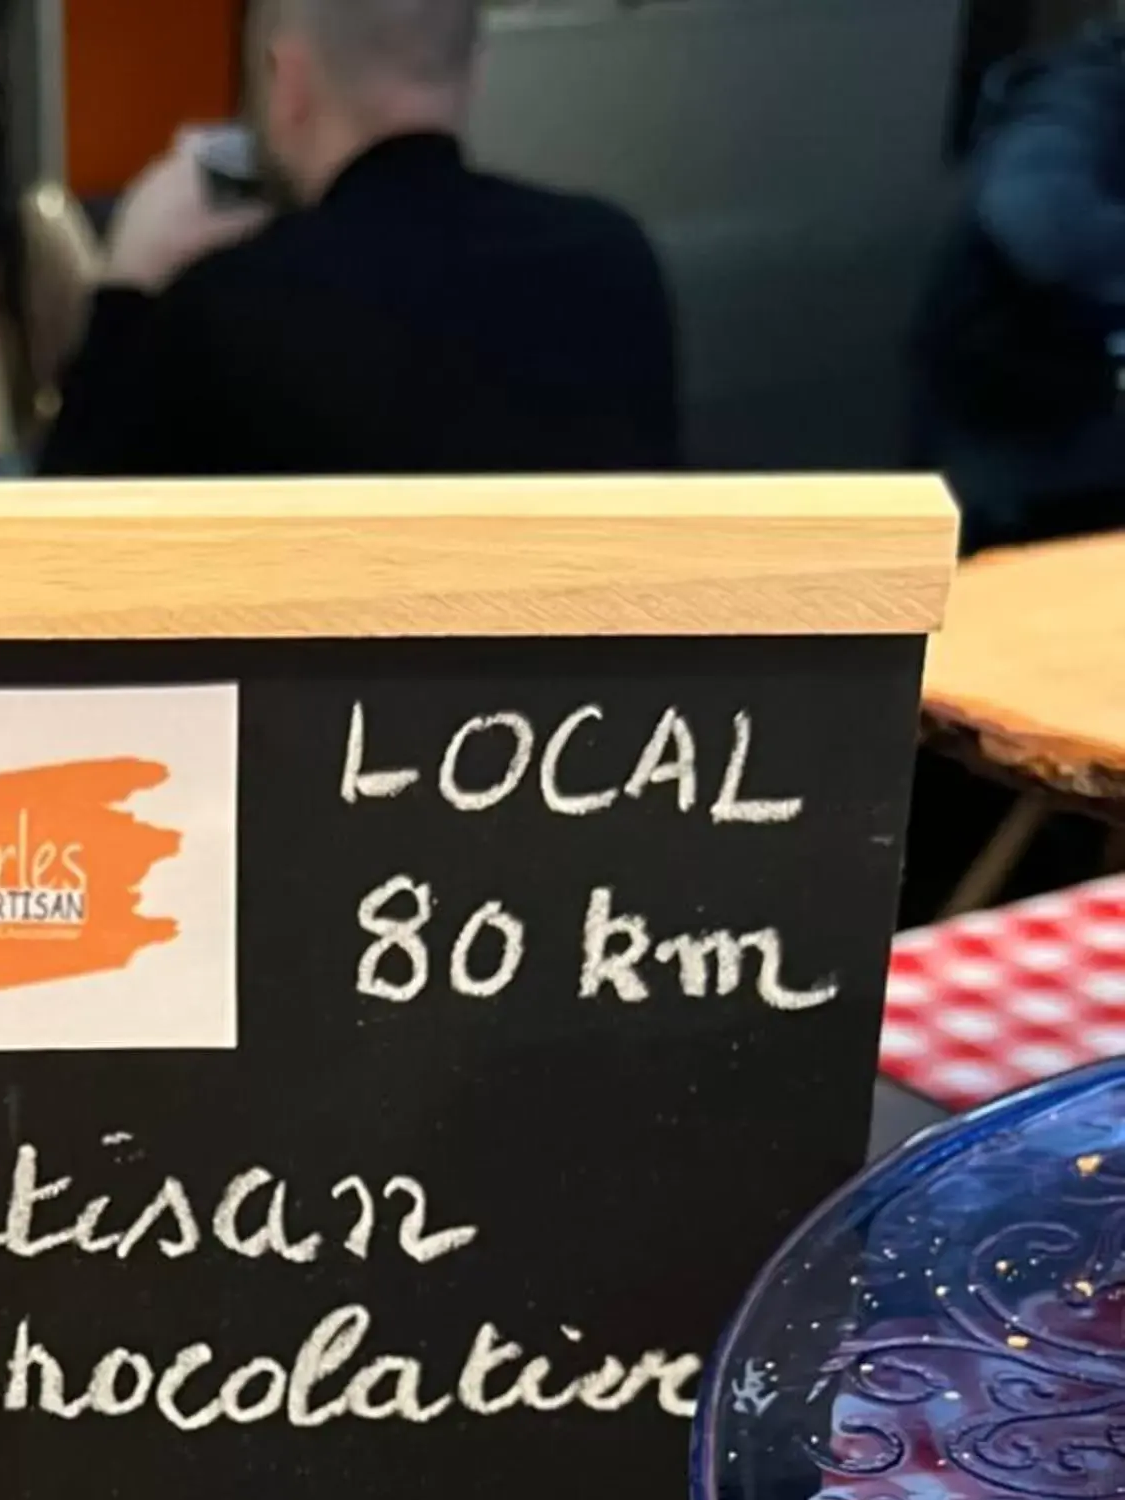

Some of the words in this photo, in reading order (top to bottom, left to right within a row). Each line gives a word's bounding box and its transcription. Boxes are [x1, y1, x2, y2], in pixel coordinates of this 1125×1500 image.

[341, 702, 802, 823] LOCAL
[357, 875, 523, 1001] 80
[579, 887, 837, 1010] km
